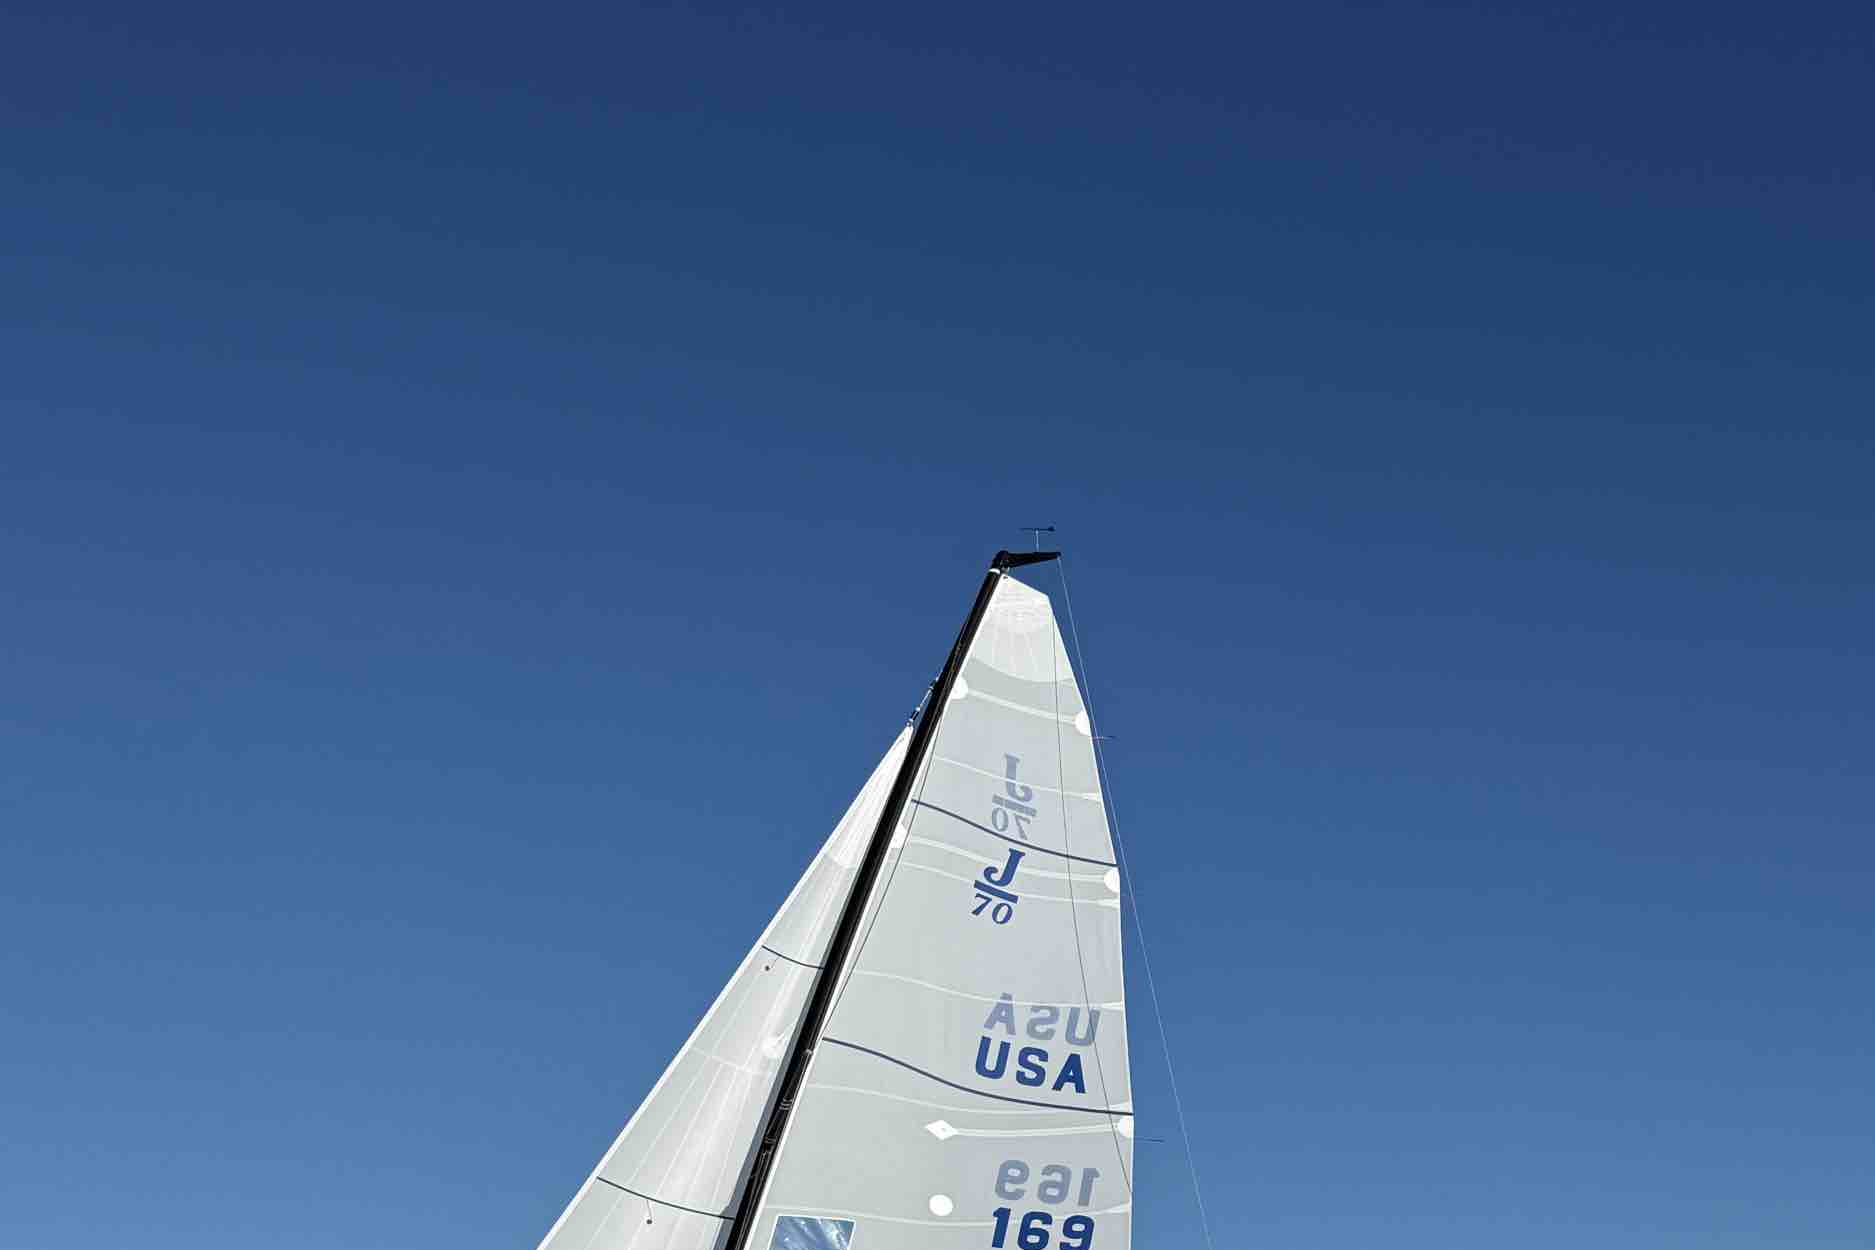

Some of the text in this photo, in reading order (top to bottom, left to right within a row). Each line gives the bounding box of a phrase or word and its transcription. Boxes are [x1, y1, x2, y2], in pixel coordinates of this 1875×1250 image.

[983, 848, 1026, 887] J
[971, 893, 1014, 924] 70
[975, 1036, 1086, 1094] USA
